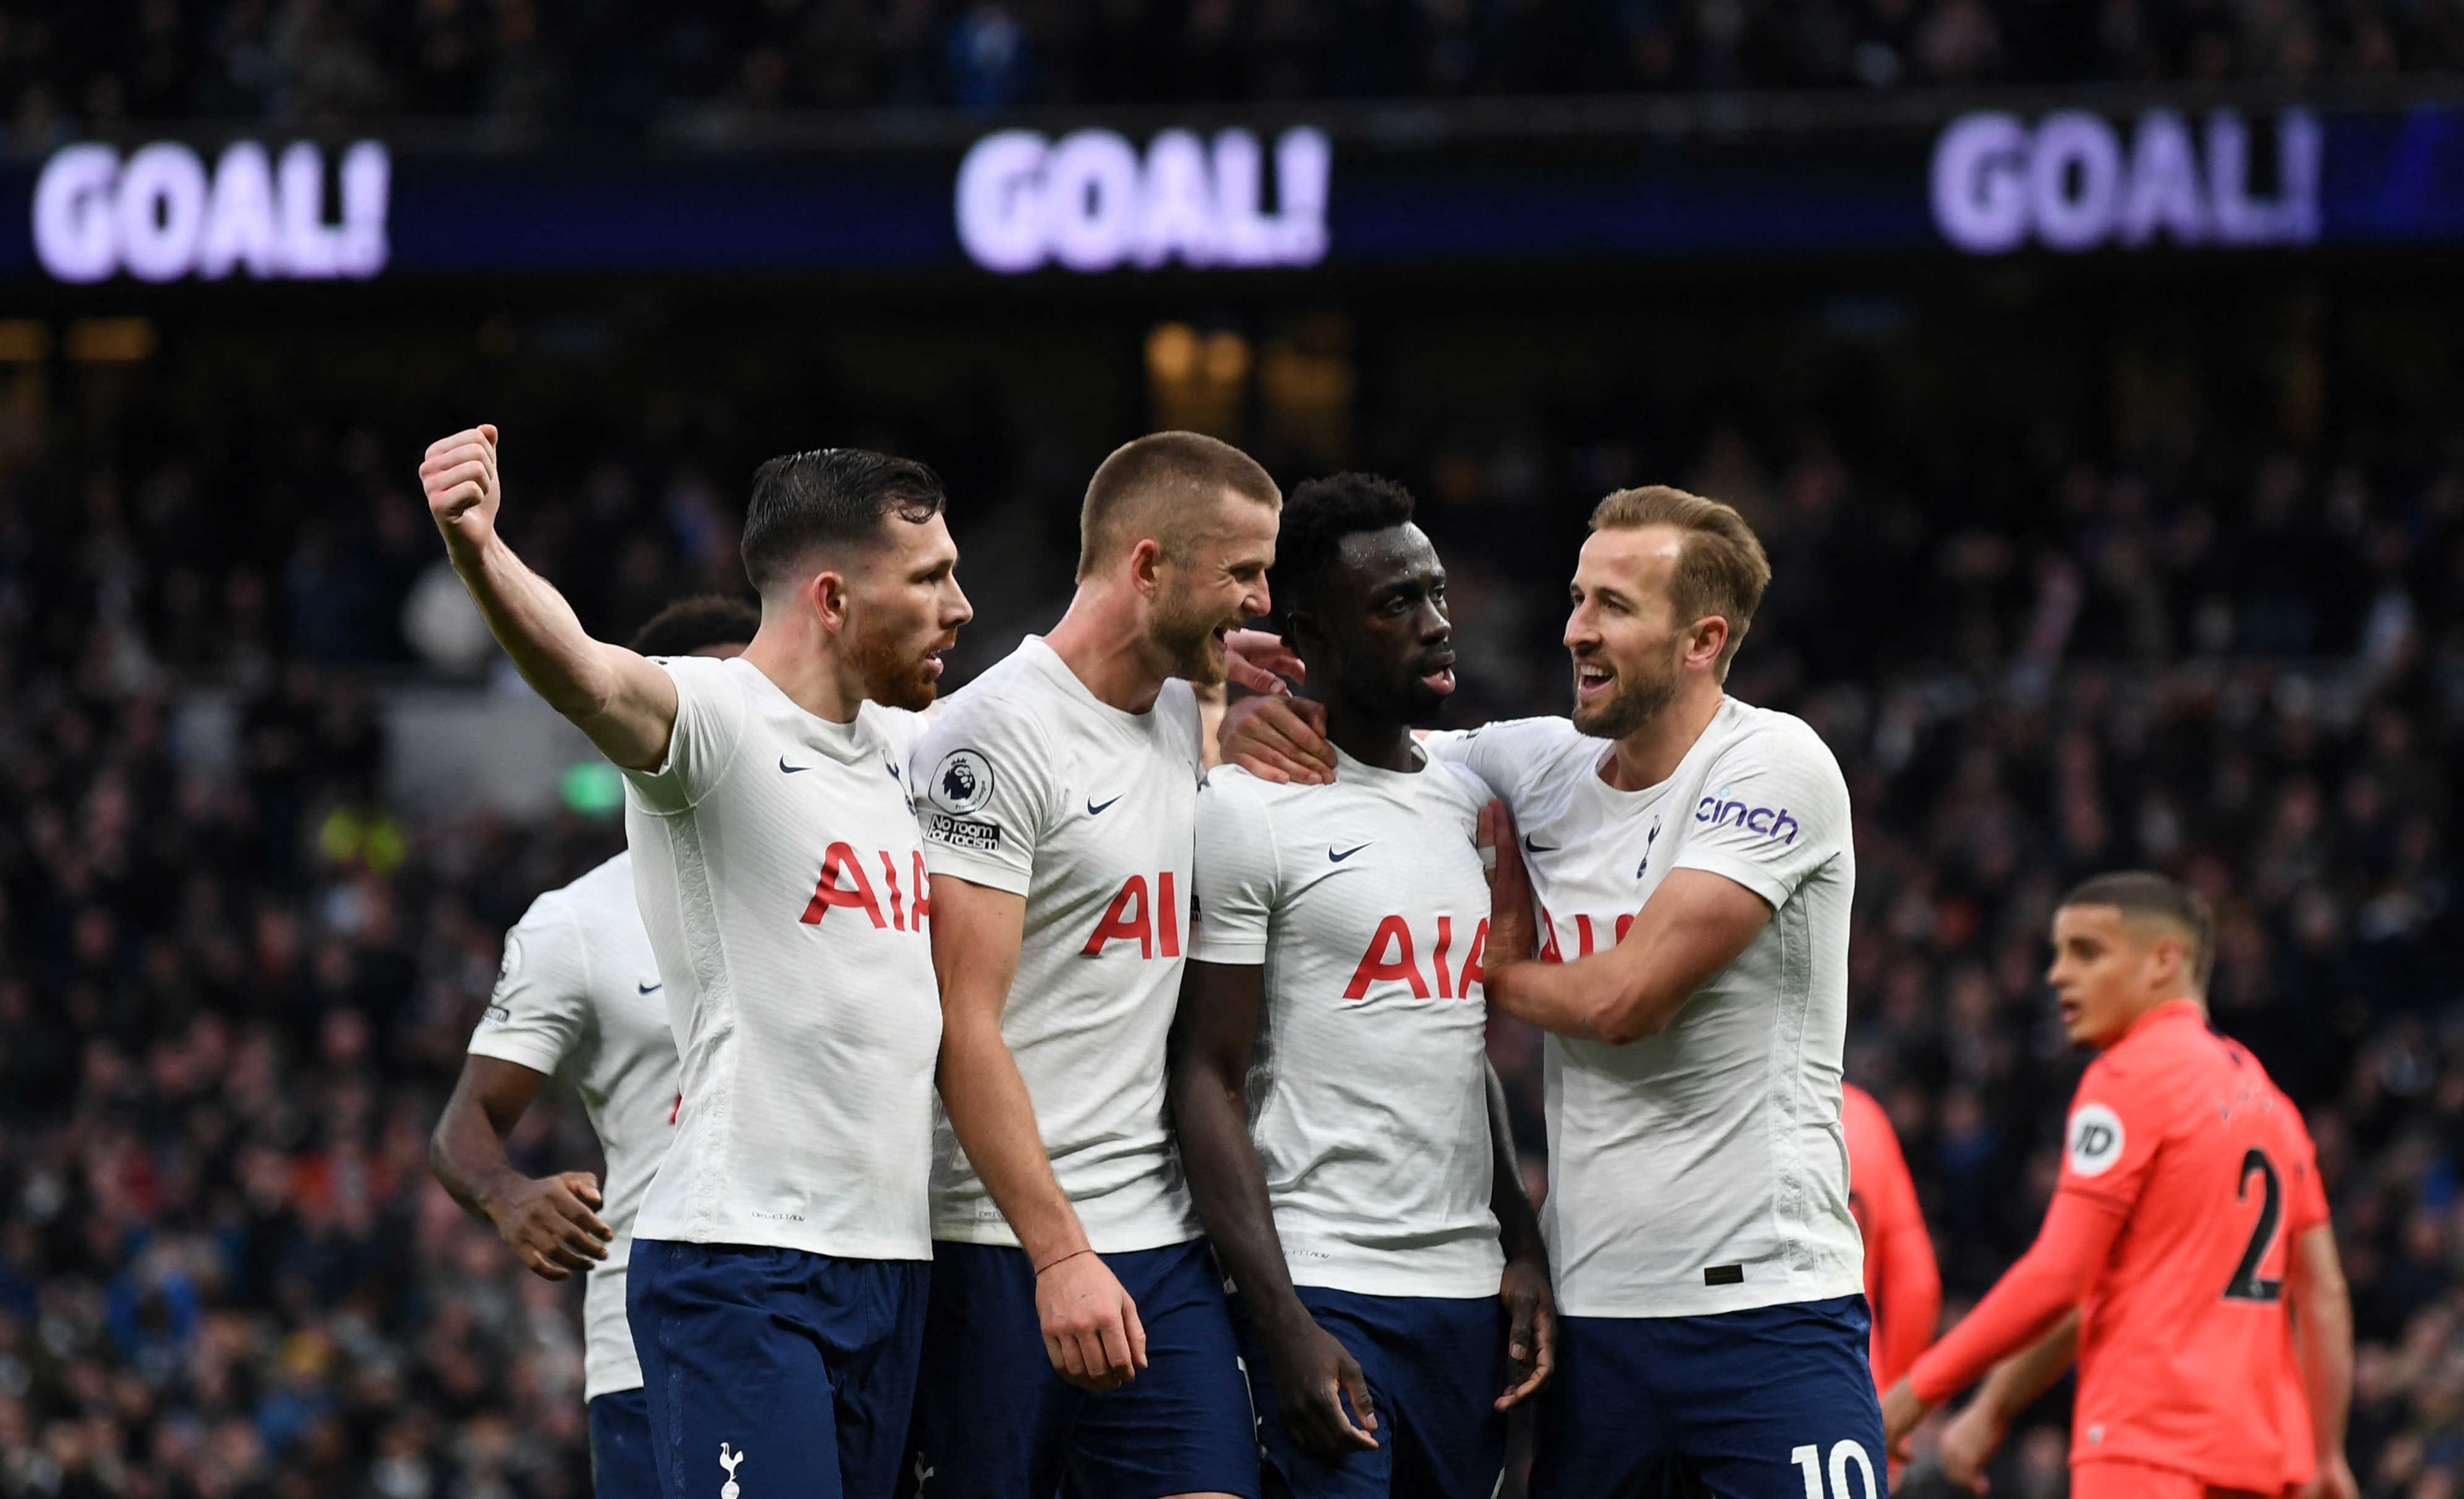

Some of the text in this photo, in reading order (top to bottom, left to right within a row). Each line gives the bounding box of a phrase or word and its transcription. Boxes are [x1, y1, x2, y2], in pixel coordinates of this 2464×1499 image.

[33, 140, 390, 283] GOAL!
[956, 126, 1330, 273] GOAL!
[1928, 108, 2322, 254] GOAL!
[930, 814, 993, 838] No room
[949, 832, 999, 851] racism
[1695, 785, 1799, 844] cinch
[2222, 1148, 2283, 1301] 2
[1791, 1439, 1878, 1499] 10
